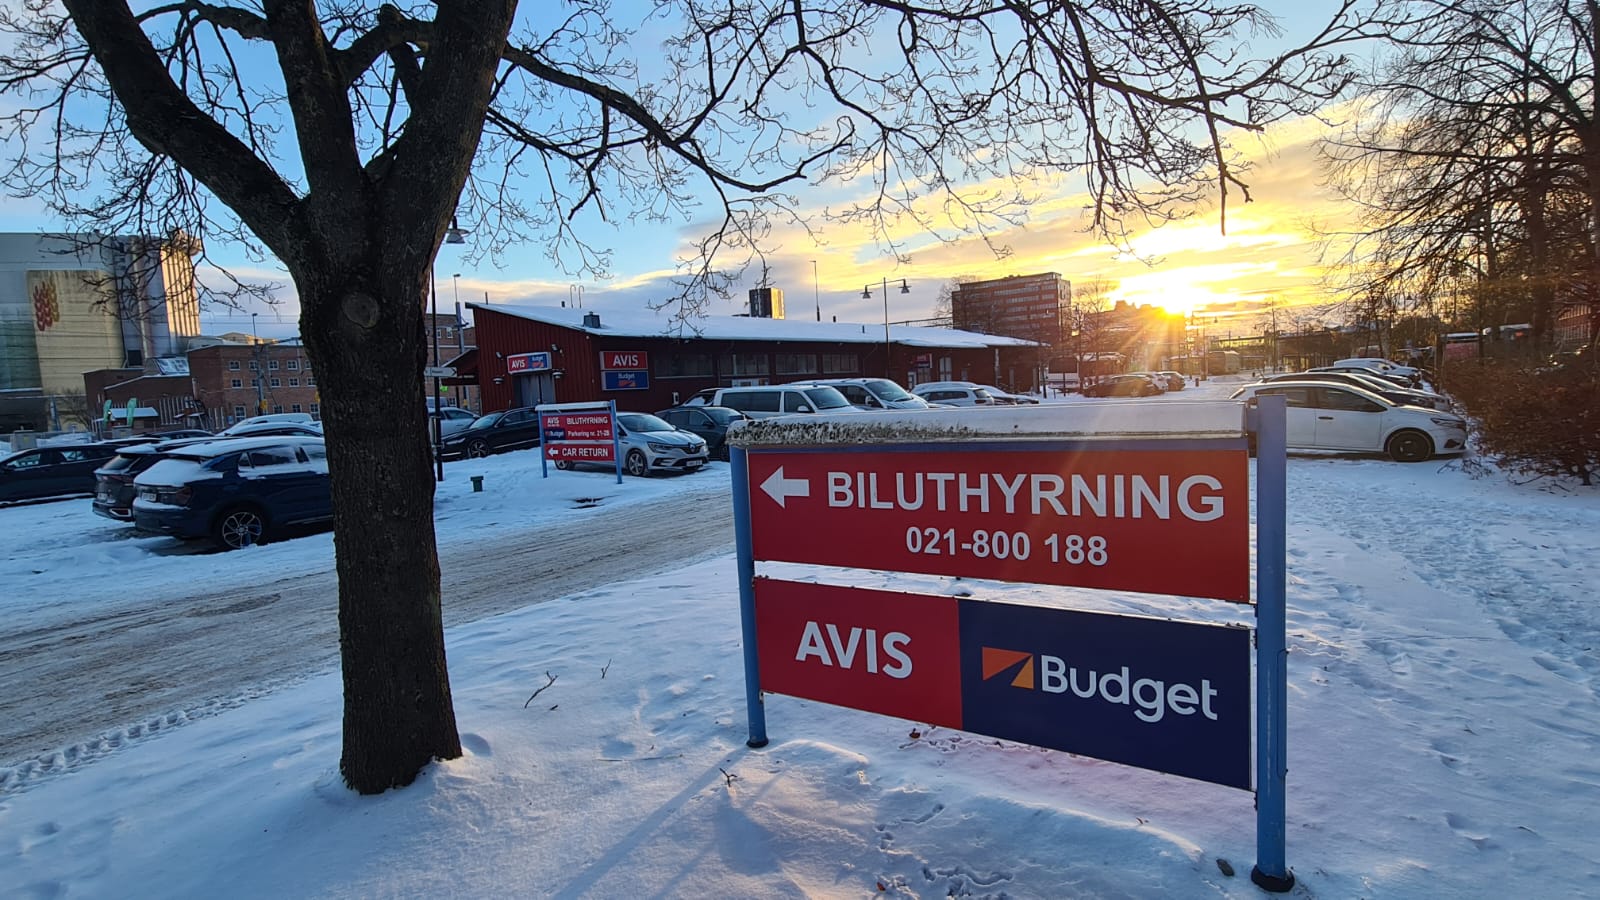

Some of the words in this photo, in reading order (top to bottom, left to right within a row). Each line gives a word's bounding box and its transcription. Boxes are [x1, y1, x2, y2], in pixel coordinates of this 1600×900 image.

[512, 360, 525, 368] AVIS
[613, 355, 639, 367] AVIS
[617, 373, 635, 381] Budget
[566, 416, 608, 425] BILUTHYRNING
[562, 448, 577, 457] CAR
[578, 448, 609, 457] RETURN
[827, 470, 1225, 522] BILUTHYRNING
[905, 526, 1031, 561] 021-800
[1044, 533, 1109, 566] 188
[795, 620, 914, 679] AVIS
[1040, 654, 1219, 723] Budget
